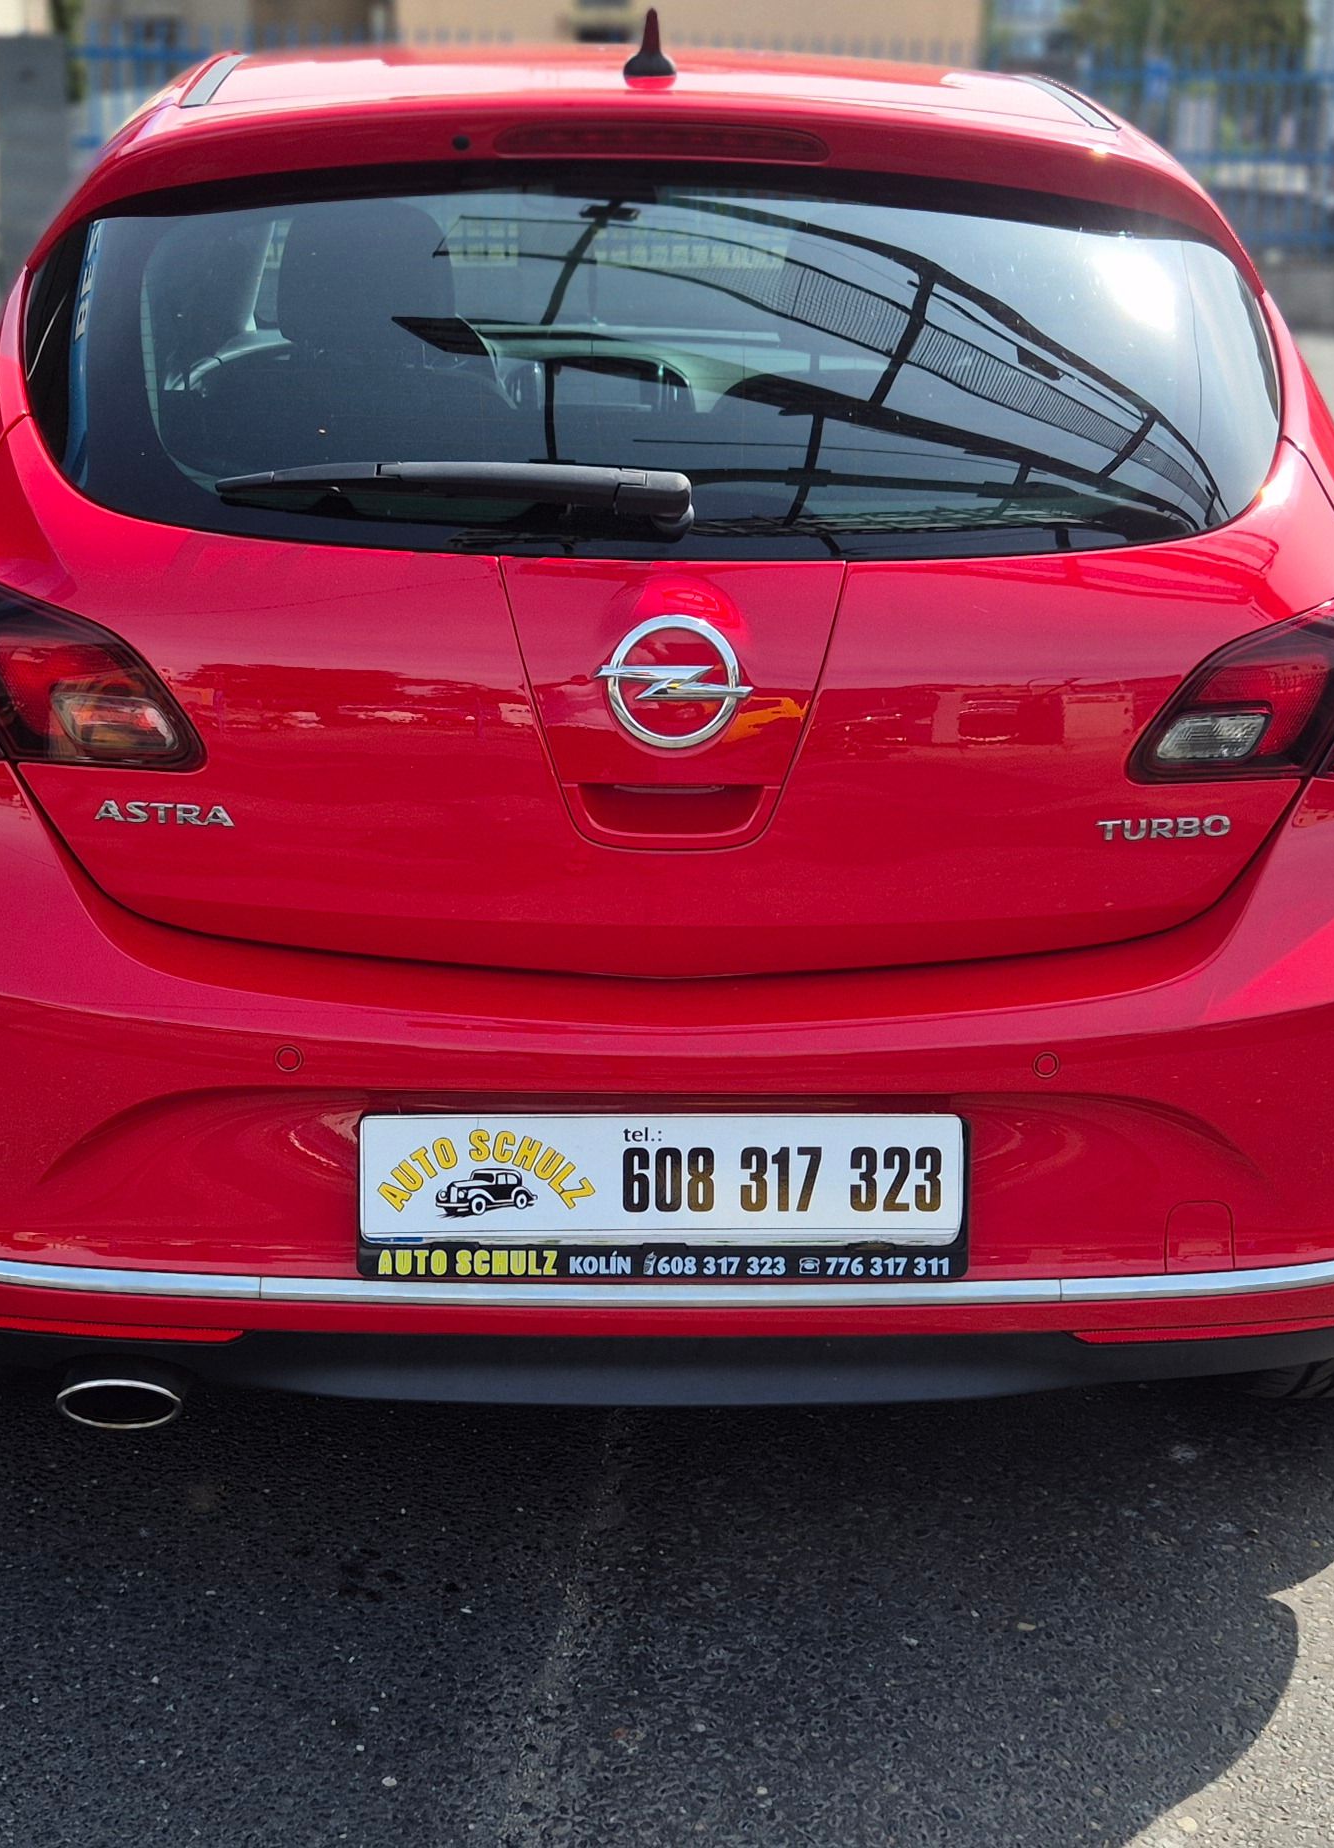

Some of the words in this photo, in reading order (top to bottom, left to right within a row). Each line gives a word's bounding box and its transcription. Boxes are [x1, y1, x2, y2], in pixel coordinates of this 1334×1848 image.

[94, 799, 236, 828] ASTRA
[1095, 814, 1232, 842] TURBO
[622, 1127, 663, 1142] tel.:
[377, 1137, 458, 1213] AUTO
[468, 1129, 596, 1210] SCHULZ
[622, 1146, 714, 1213] 608
[740, 1146, 822, 1212] 317
[850, 1146, 942, 1212] 323
[377, 1249, 449, 1276] AUTO
[455, 1249, 558, 1276] SCHULZ
[569, 1250, 632, 1275] KOLÍN
[657, 1256, 697, 1276] 608
[702, 1256, 741, 1276] 317
[746, 1256, 787, 1276] 323
[825, 1256, 865, 1276] 776
[869, 1256, 908, 1276] 317
[913, 1256, 951, 1276] 311
